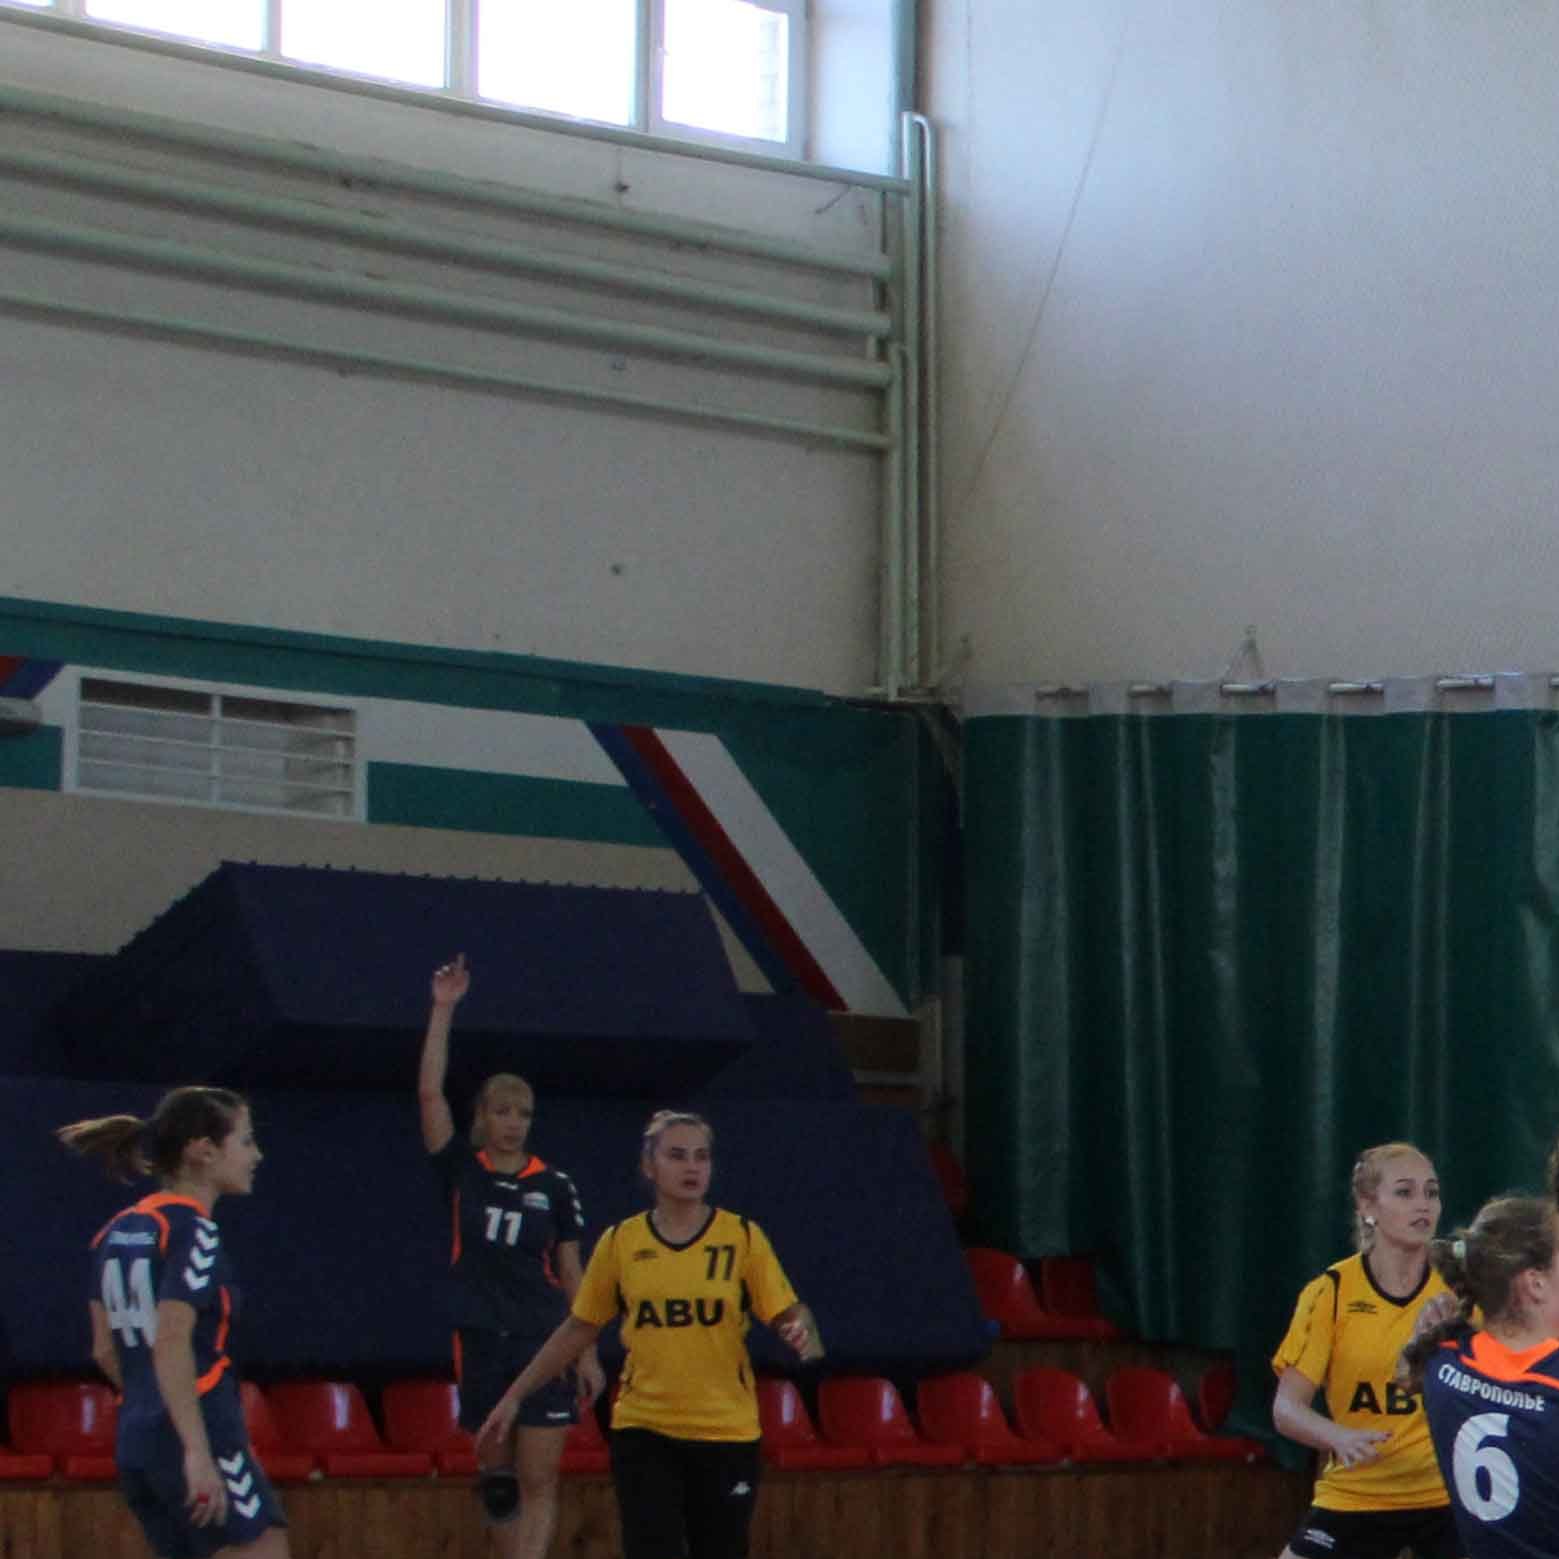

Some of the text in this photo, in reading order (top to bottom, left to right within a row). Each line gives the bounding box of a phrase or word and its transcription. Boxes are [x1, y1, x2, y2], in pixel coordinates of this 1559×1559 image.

[101, 1258, 157, 1347] 44
[635, 1297, 725, 1329] ABU
[1346, 1381, 1418, 1415] AB
[1438, 1363, 1545, 1412] СТАВРОПОЛЬЕ
[1453, 1411, 1519, 1522] 6
